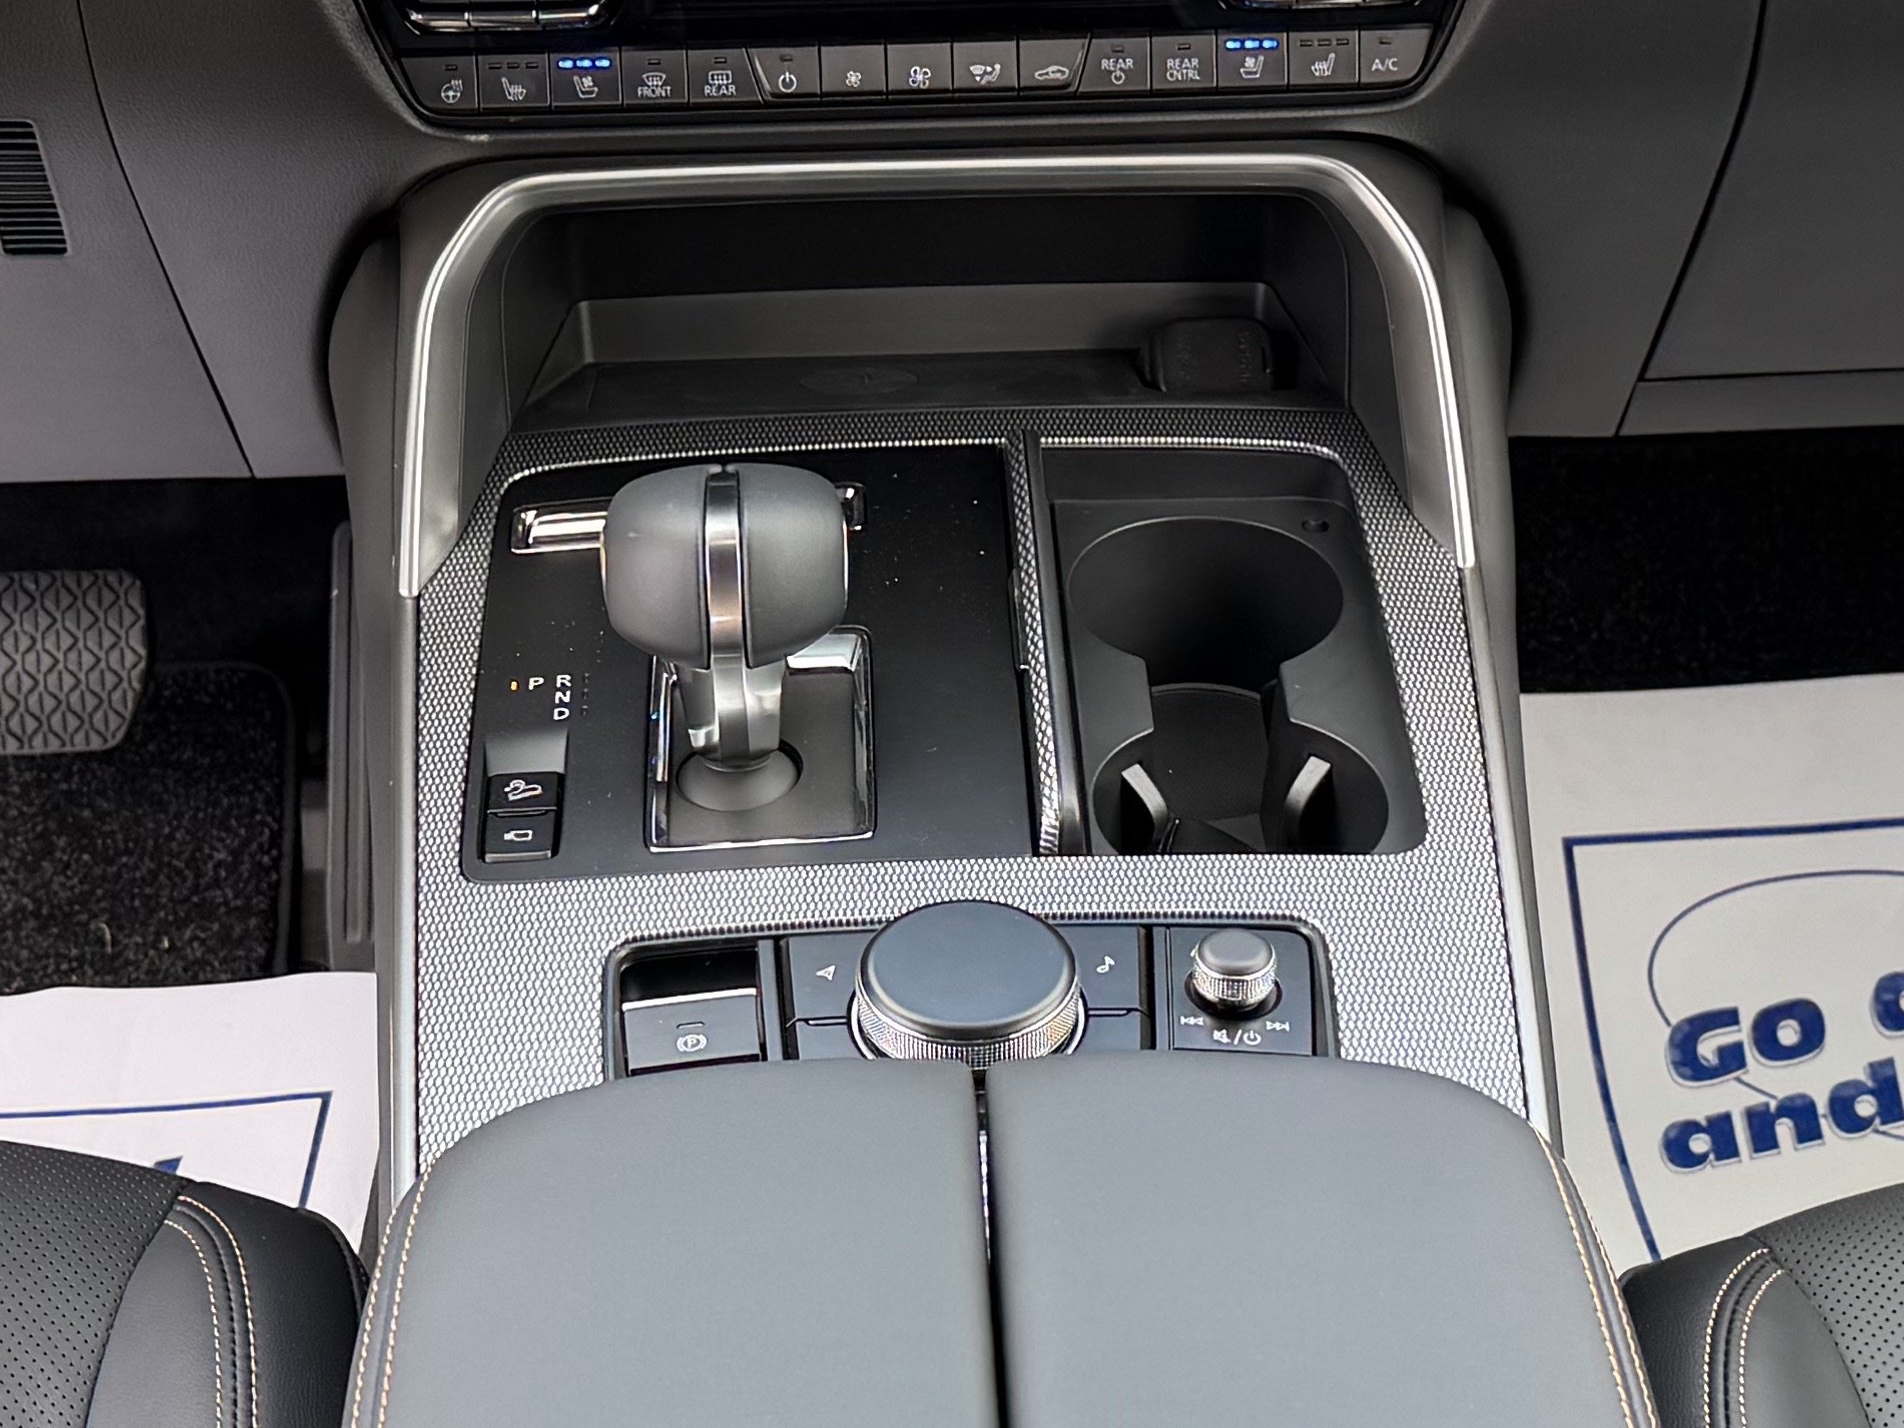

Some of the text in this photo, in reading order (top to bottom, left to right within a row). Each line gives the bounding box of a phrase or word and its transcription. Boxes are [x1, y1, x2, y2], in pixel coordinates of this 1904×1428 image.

[1101, 58, 1134, 71] REAR
[1166, 58, 1200, 71] REAR
[1371, 57, 1398, 72] A/C
[637, 85, 671, 99] FRONT
[704, 84, 736, 97] REAR
[528, 676, 544, 691] P
[556, 674, 571, 688] R
[555, 690, 570, 704] N
[553, 707, 570, 721] D
[1664, 996, 1827, 1088] Go
